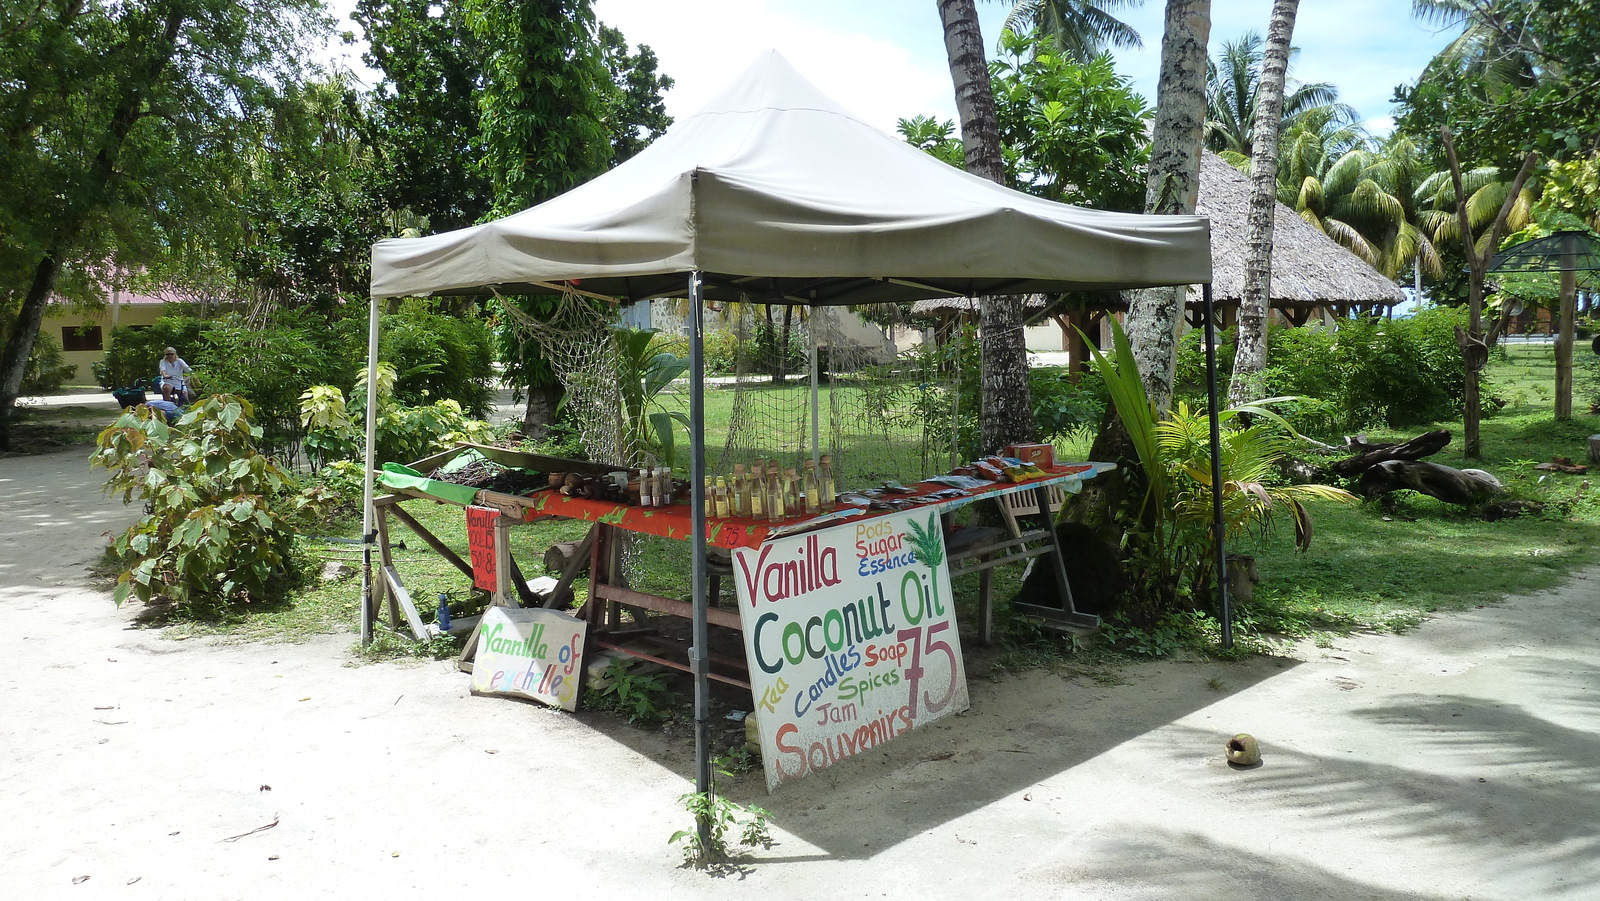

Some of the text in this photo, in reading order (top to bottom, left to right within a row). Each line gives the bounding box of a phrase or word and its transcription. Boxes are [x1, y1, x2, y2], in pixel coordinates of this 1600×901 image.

[724, 527, 740, 546] 75
[856, 519, 893, 542] Pods
[856, 531, 906, 564] Sugar
[736, 534, 842, 608] Vanilla
[858, 551, 917, 577] Essence
[754, 565, 945, 674] Coconut Oil
[481, 623, 581, 675] Vannilla of
[896, 620, 957, 719] 75
[473, 654, 575, 700] Seychelles
[758, 677, 790, 715] Tea
[794, 642, 908, 718] Candles Soap
[837, 668, 900, 707] Spices
[815, 702, 857, 726] Jam
[775, 705, 914, 783] Souvenirs
